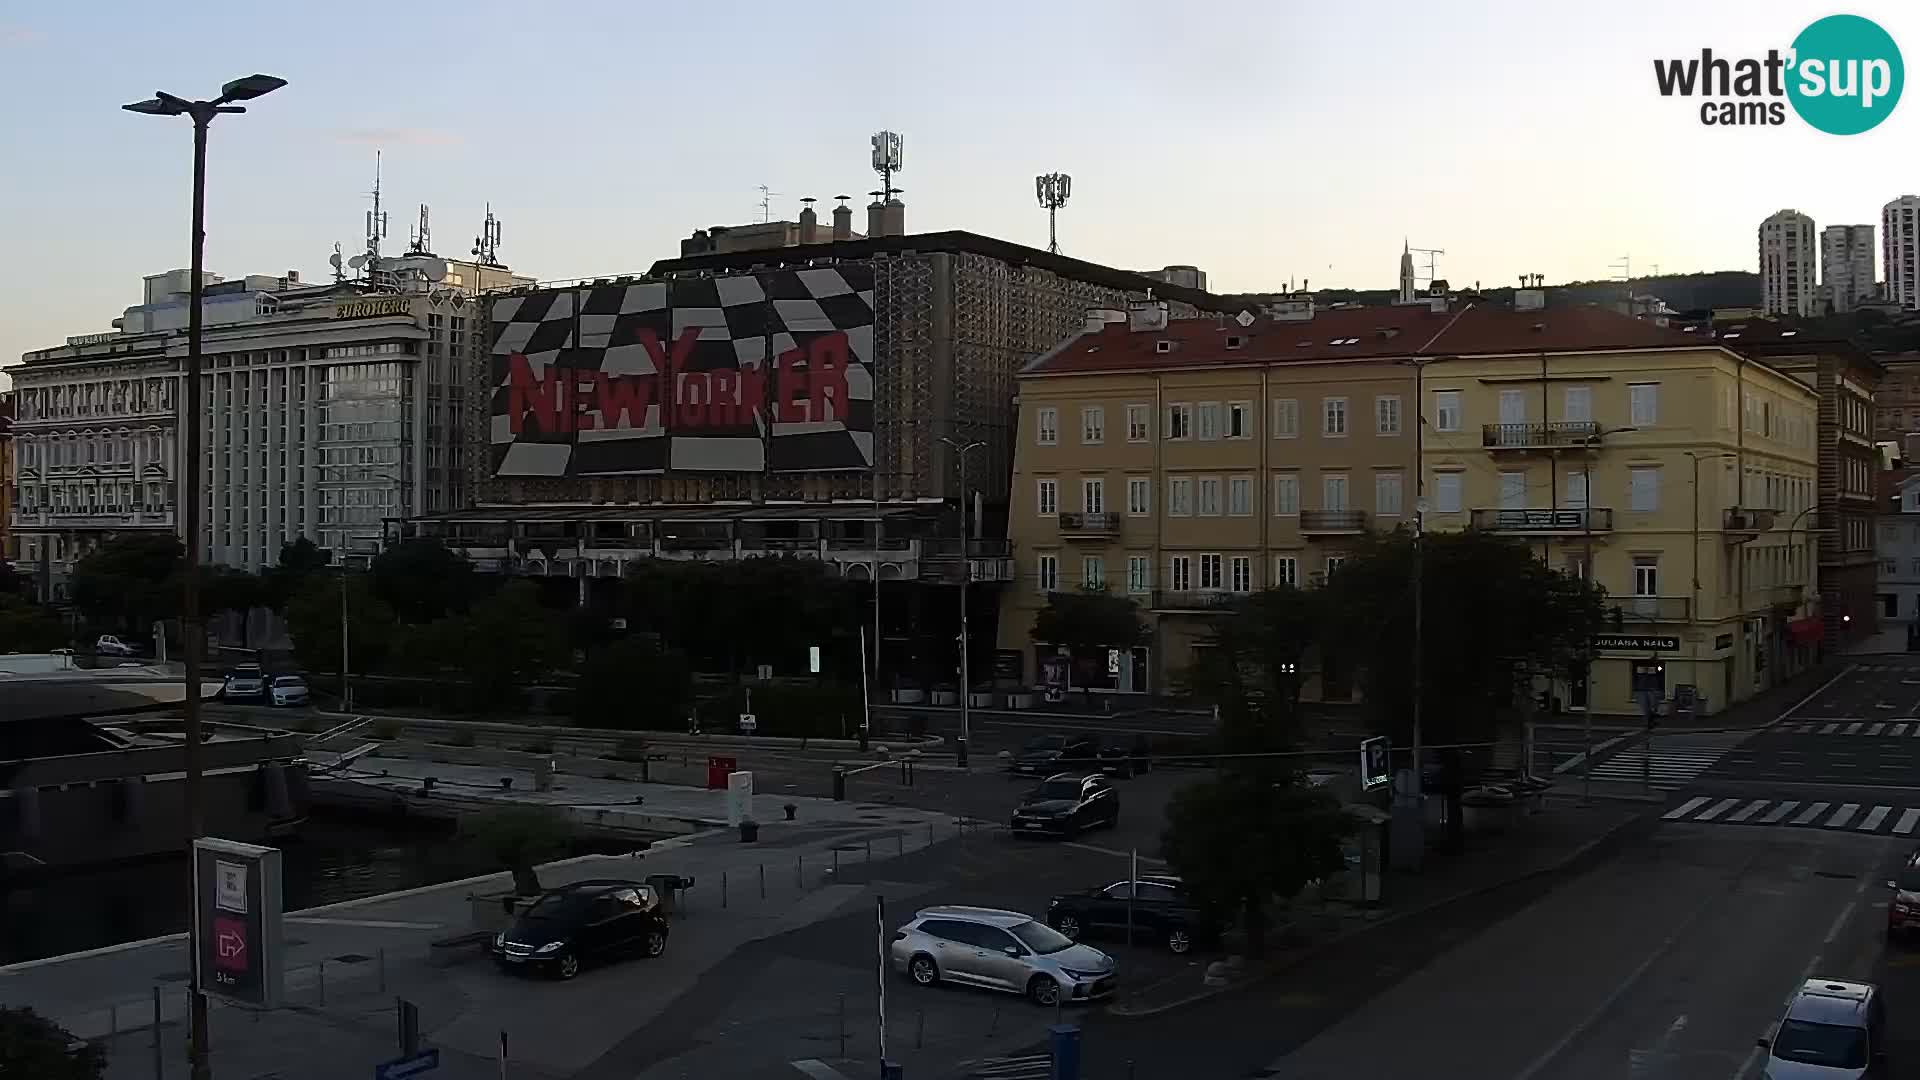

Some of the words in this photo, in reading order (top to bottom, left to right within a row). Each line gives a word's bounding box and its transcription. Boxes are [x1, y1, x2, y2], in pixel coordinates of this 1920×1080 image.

[509, 350, 662, 433] NEW
[634, 326, 849, 427] YORKER
[1643, 639, 1674, 648] NAILS
